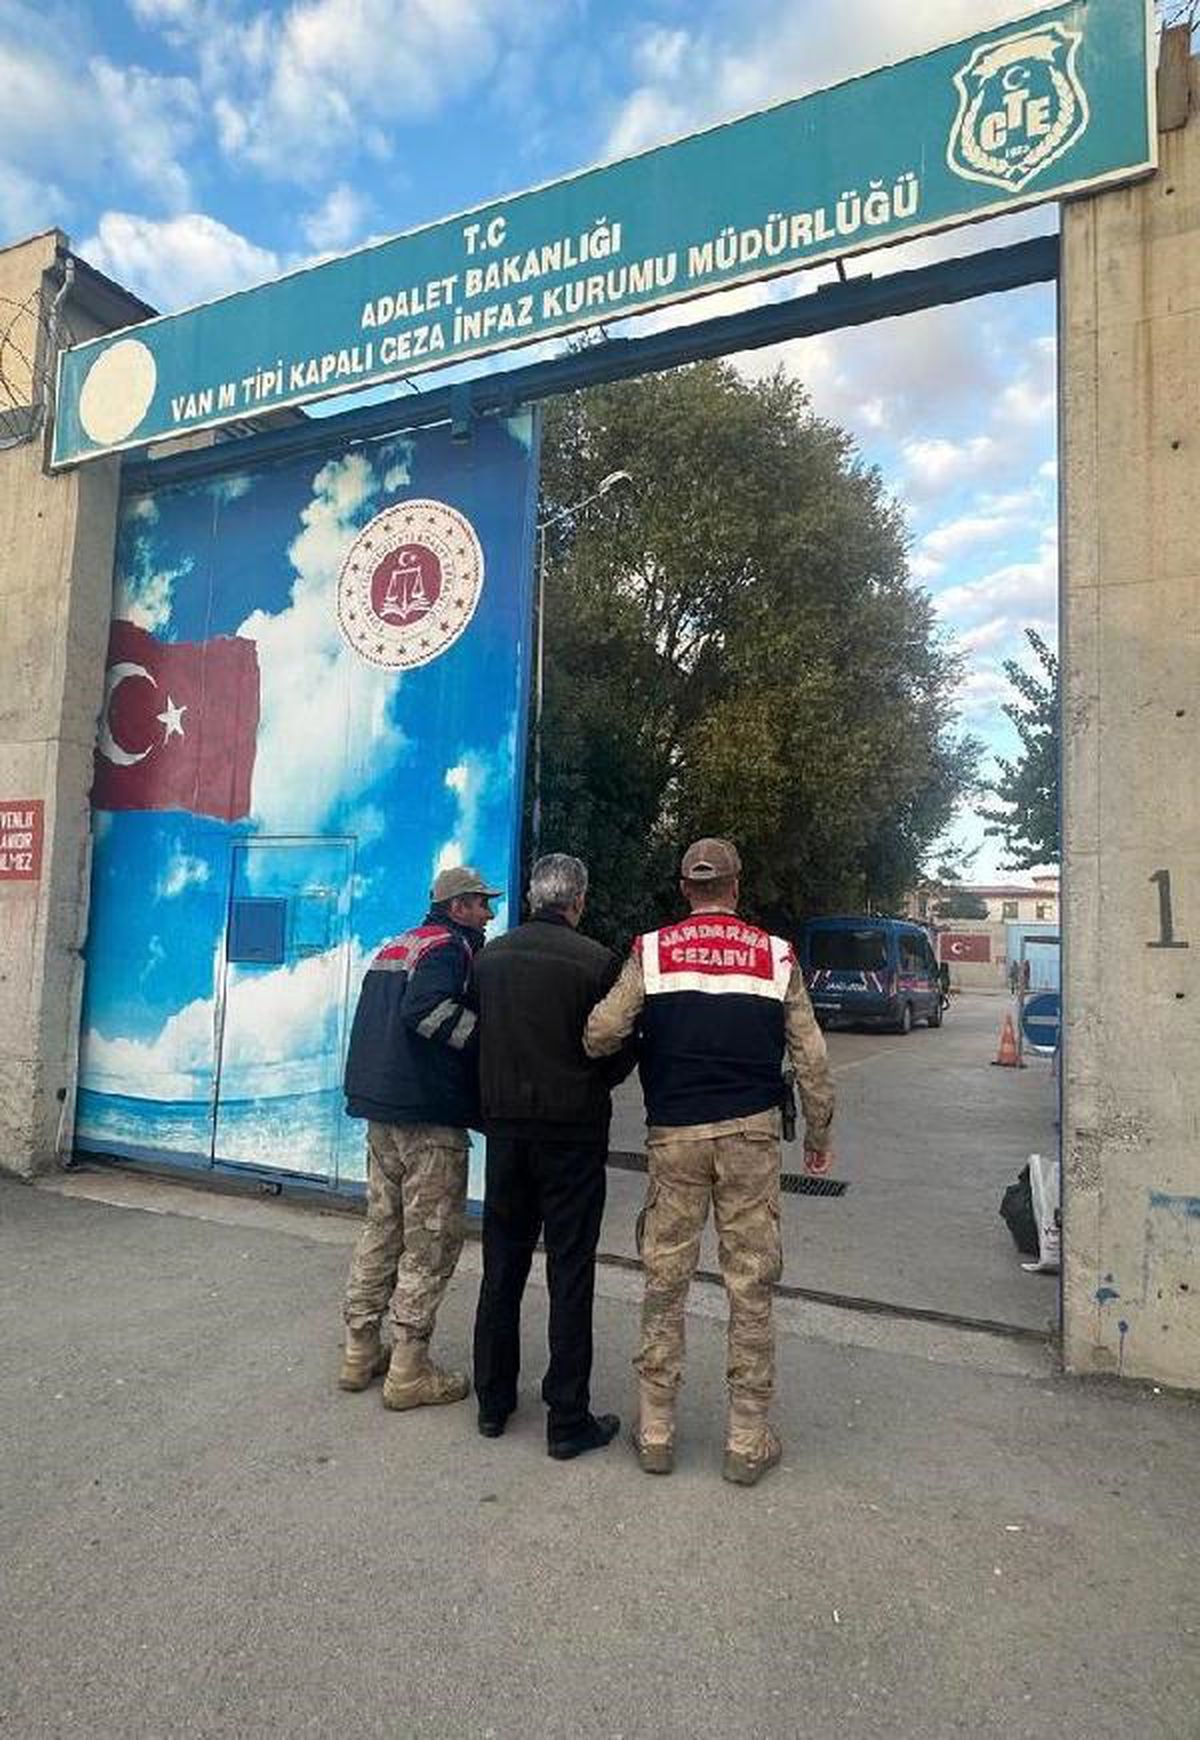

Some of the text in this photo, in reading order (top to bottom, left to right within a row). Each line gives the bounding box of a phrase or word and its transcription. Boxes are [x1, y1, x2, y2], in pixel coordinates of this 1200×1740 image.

[361, 217, 622, 329] ADALET BAKANLIĞI
[463, 217, 506, 255] T.C
[171, 172, 920, 422] VAN M TİPİ KAPALI CEZA İNFAZ KURUMU MÜDÜRLÜĞÜ
[1147, 869, 1189, 948] 1
